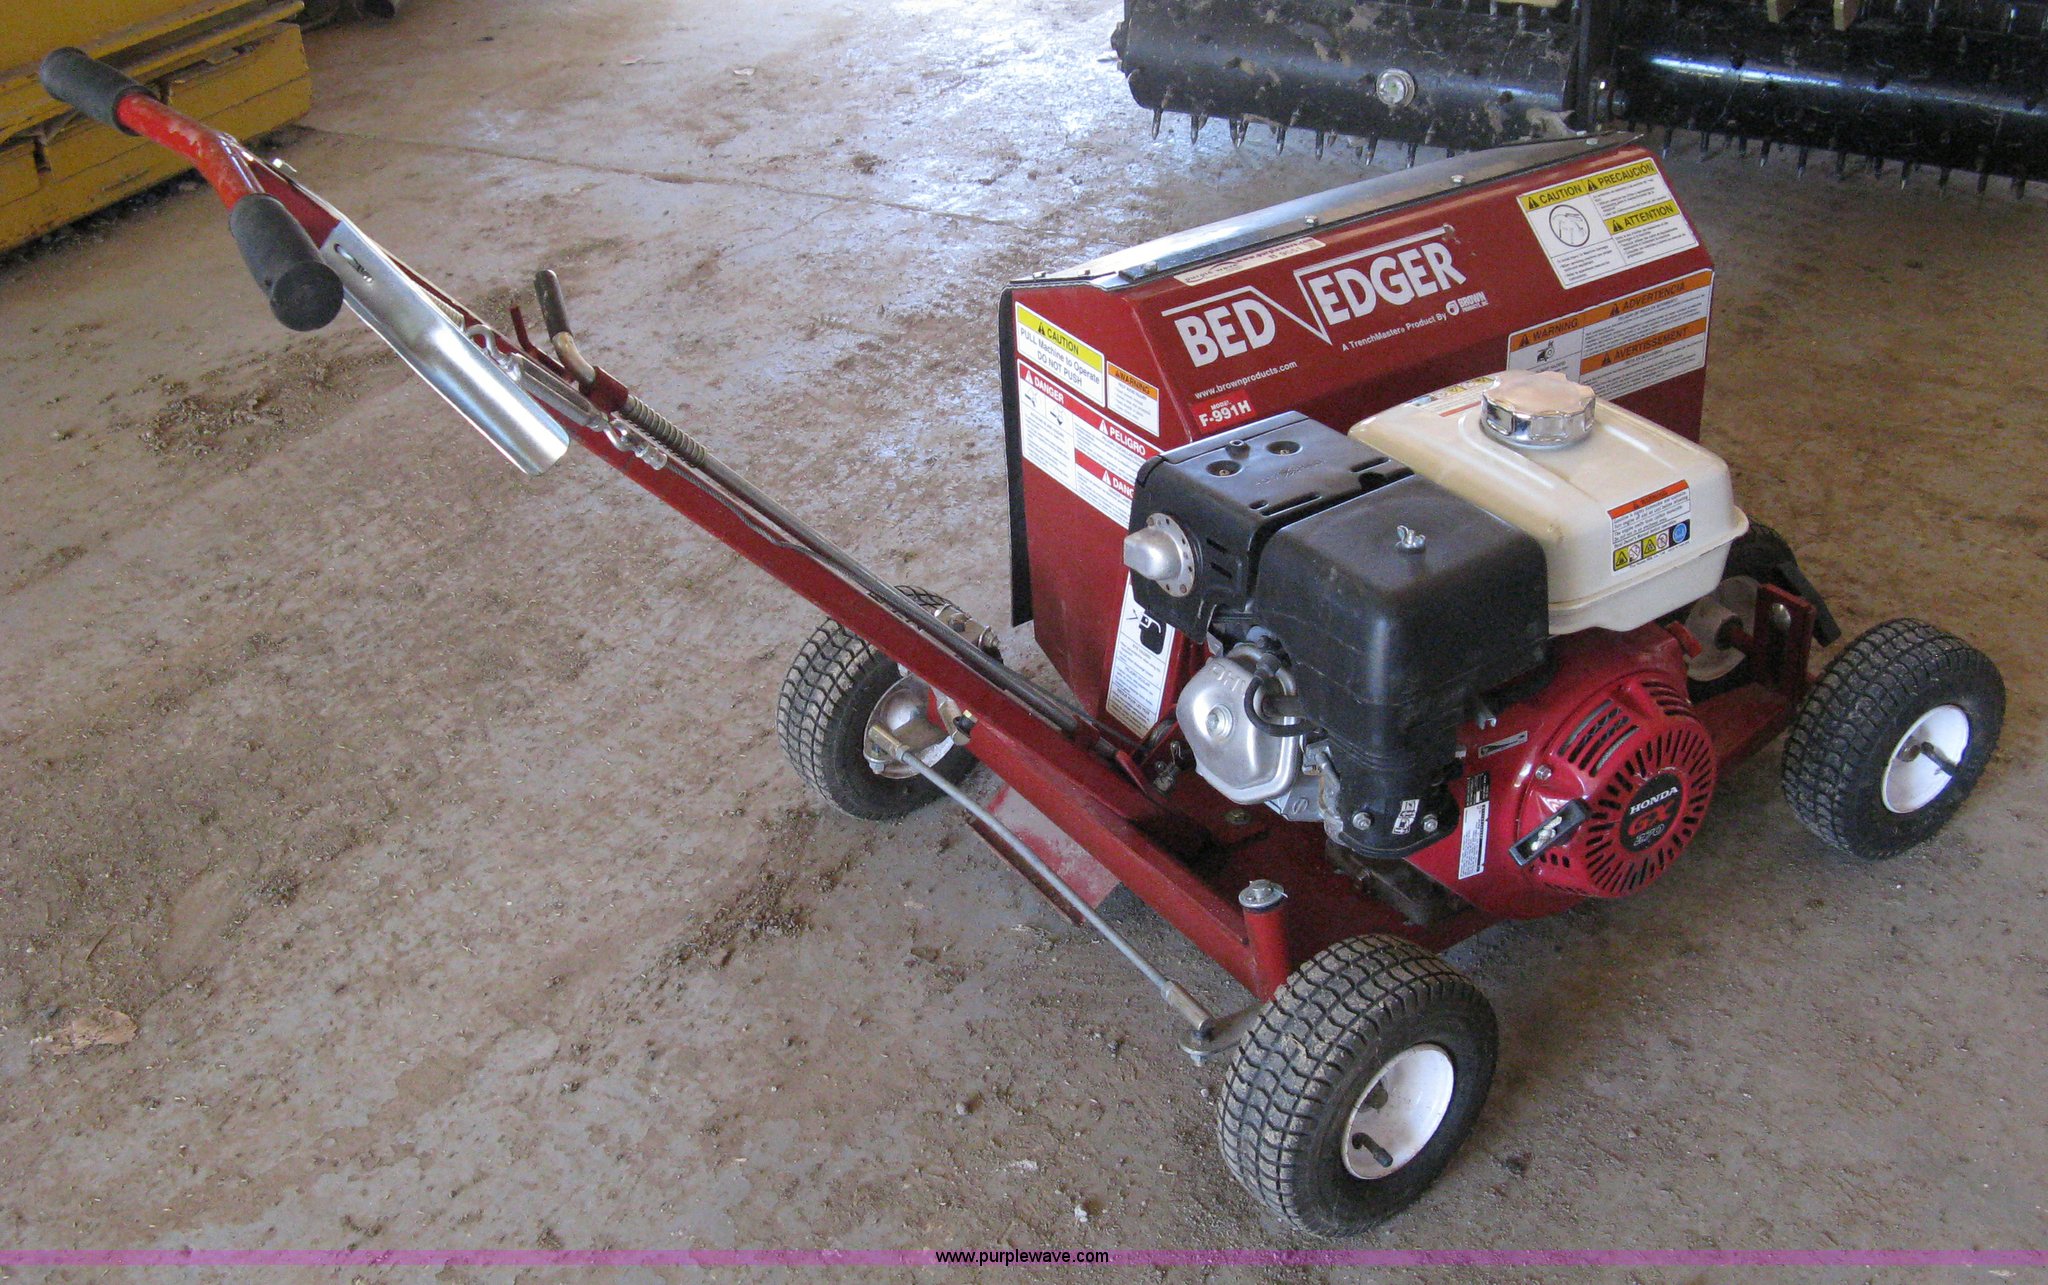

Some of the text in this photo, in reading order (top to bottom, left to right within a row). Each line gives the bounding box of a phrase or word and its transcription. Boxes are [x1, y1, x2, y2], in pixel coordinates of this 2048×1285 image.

[1599, 162, 1654, 186] PRECAUCIÓN
[1539, 185, 1582, 204] CAUTION
[1624, 204, 1674, 227] ATTENTION
[1174, 299, 1276, 368] BED
[1308, 242, 1467, 325] EDGER
[1623, 282, 1685, 311] ADVERTENCIA
[1046, 328, 1079, 355] CAUTION
[1342, 343, 1349, 352] A
[1405, 315, 1435, 331] Product
[1436, 312, 1447, 323] By
[1533, 318, 1578, 339] WARNING
[1020, 327, 1100, 385] PULL Machine to Operate
[1616, 328, 1688, 359] AVERTISSEMENT
[1037, 350, 1082, 387] DO NOT PUSH
[1194, 361, 1298, 399] www.brownproducts.com
[1034, 376, 1065, 405] DANGER
[1198, 400, 1252, 427] F-991H
[1109, 426, 1146, 456] PELIGRO
[1629, 786, 1679, 815] HONDA
[1628, 800, 1675, 836] GX
